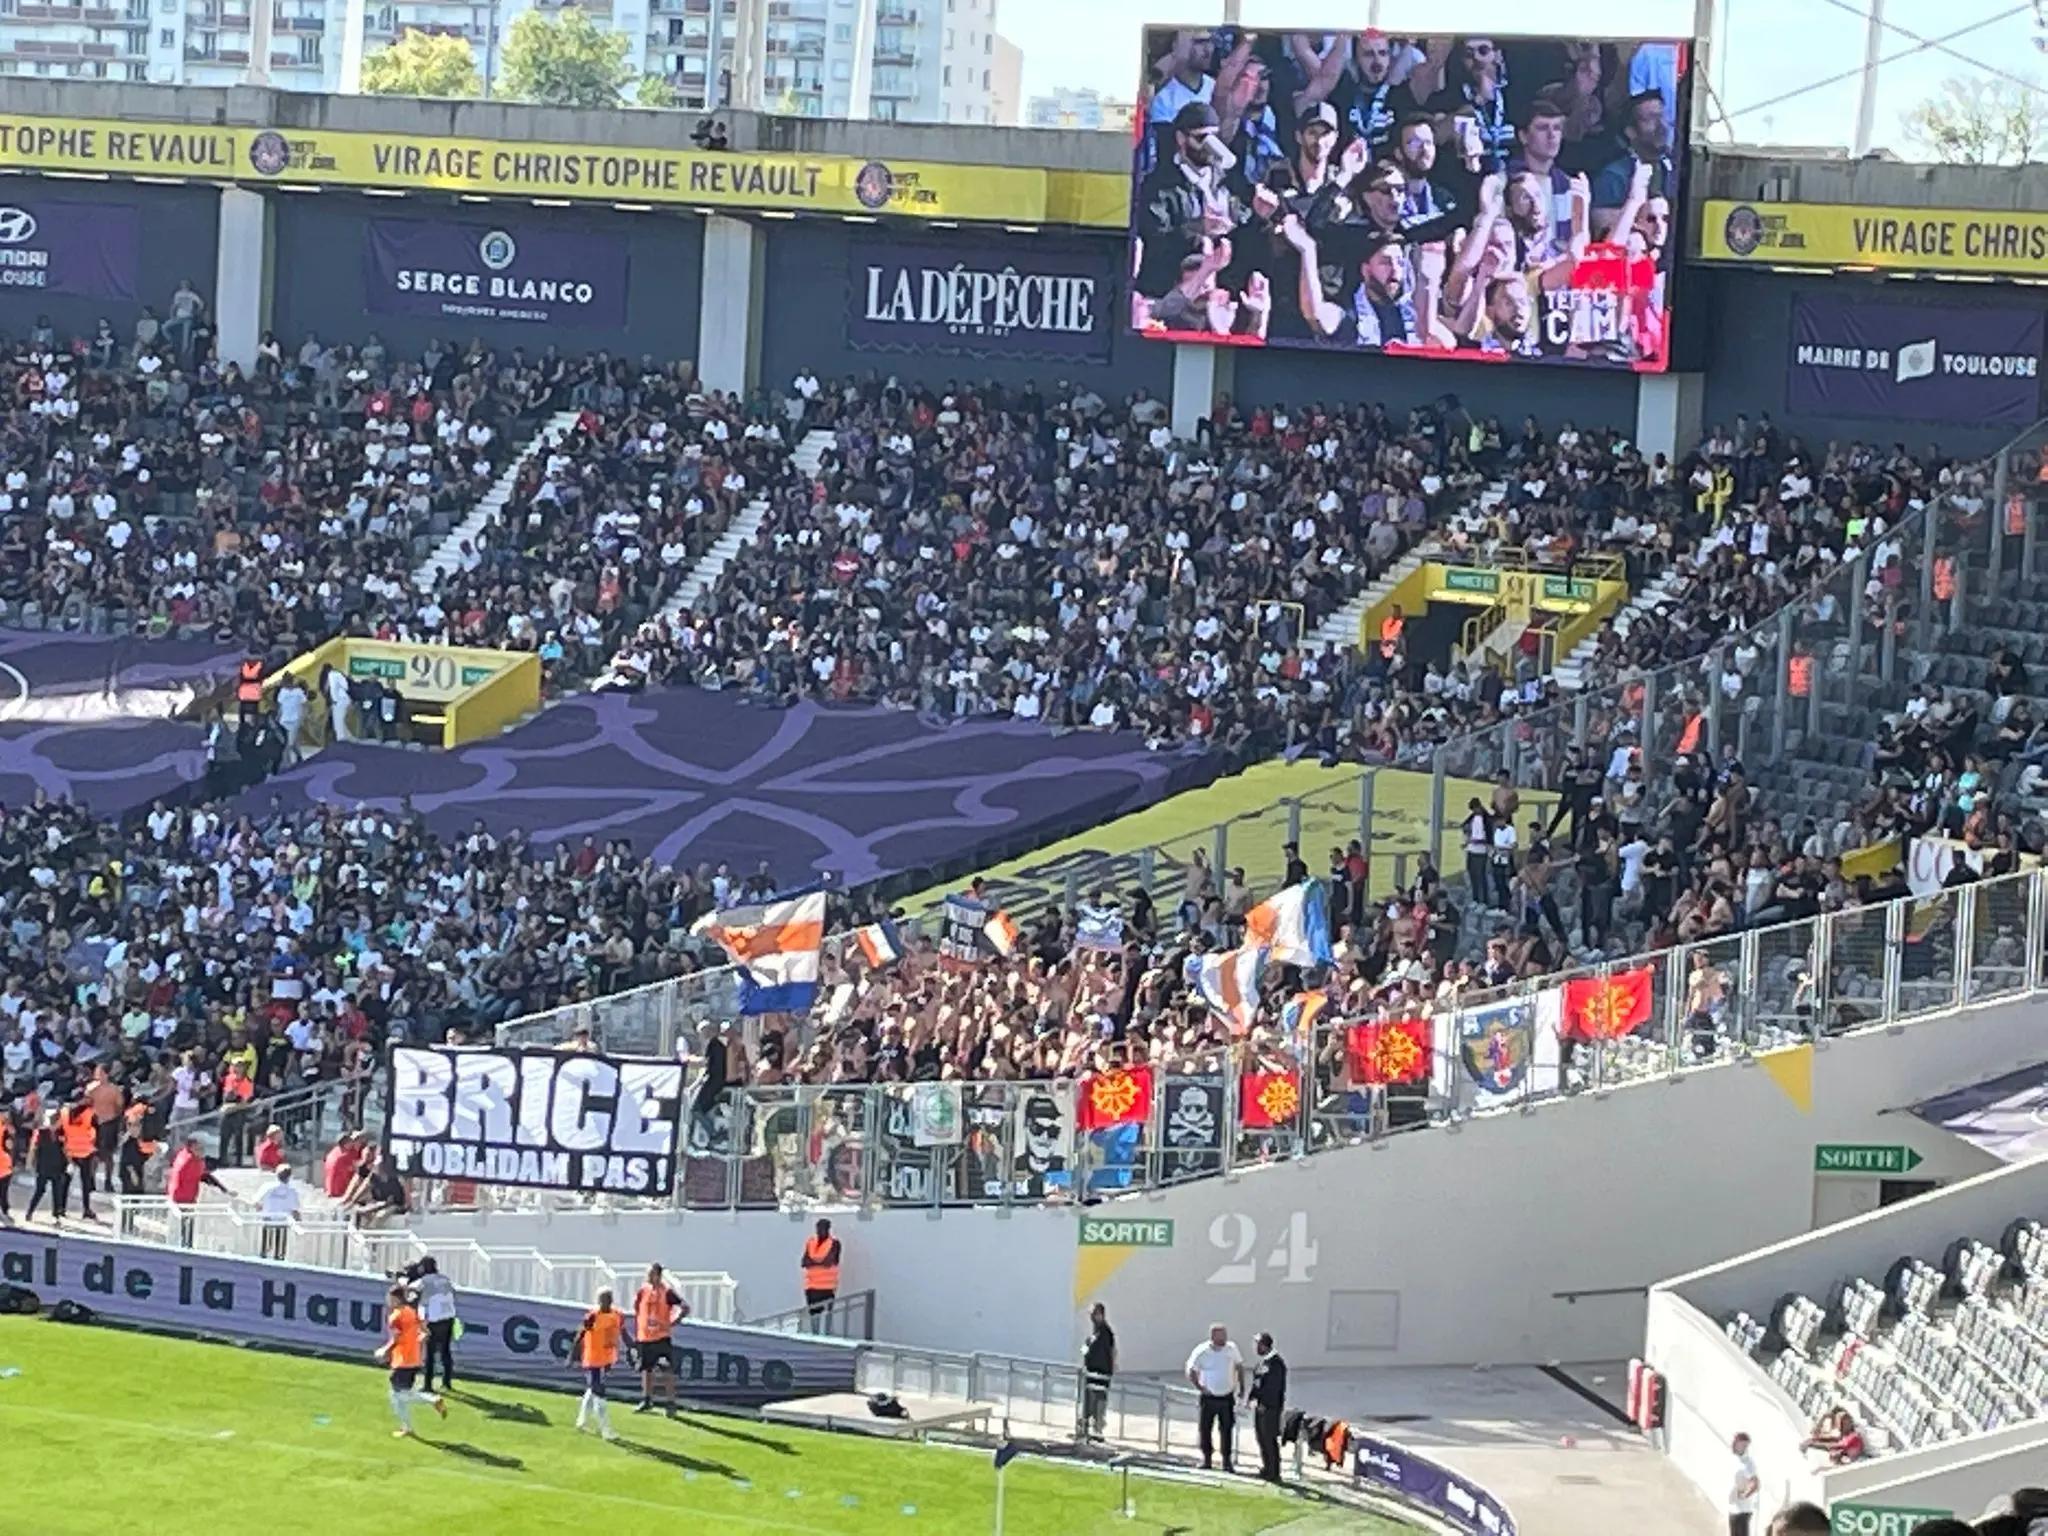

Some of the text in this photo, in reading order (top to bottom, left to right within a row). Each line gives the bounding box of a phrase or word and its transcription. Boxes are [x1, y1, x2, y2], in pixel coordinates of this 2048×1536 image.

[373, 144, 484, 179] VIRAGE
[494, 152, 680, 190] CHRISTOPHE
[690, 161, 822, 197] REVAULT
[1853, 218, 2048, 260] VIRAGE CHRIS
[397, 270, 593, 303] SERGE BLANCO
[865, 263, 1094, 332] LA DÉPÊCHE
[1798, 345, 2037, 377] MAIRIE DE TOULOUSE
[411, 655, 457, 690] 20
[391, 1047, 683, 1155] BRICE
[390, 1139, 569, 1185] T'OBLIDAM
[582, 1153, 649, 1191] PAS
[1819, 1149, 1900, 1168] SORTIE
[1083, 1212, 1319, 1285] SORTIE 24
[83, 1255, 153, 1300] de
[179, 1266, 235, 1311] la
[1837, 1510, 1949, 1536] SORT
